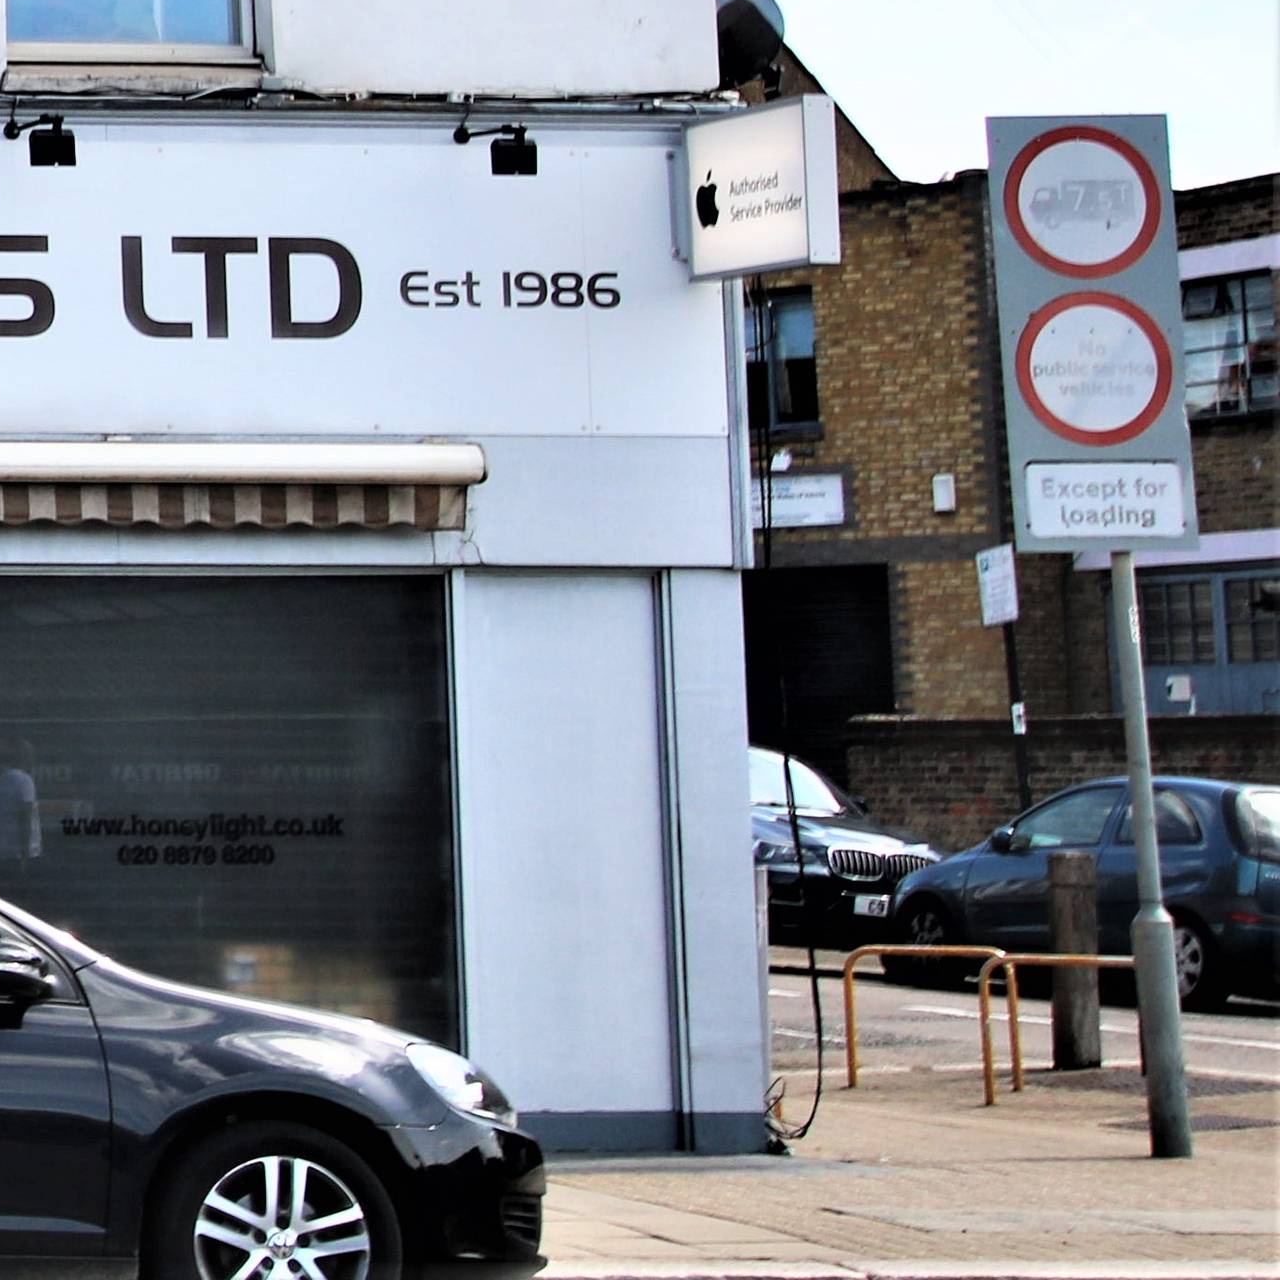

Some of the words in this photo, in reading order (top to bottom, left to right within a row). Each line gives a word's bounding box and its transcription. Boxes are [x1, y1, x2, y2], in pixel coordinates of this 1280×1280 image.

[729, 171, 779, 197] Authorised
[730, 202, 762, 222] Service
[764, 193, 802, 214] Provider
[120, 235, 363, 339] LTD
[400, 271, 481, 308] Est
[502, 271, 621, 308] 1986
[1033, 361, 1088, 378] public
[1042, 477, 1127, 501] Except
[1135, 477, 1168, 497] for
[1060, 505, 1156, 528] loading
[62, 813, 344, 842] www.honeylight.co.uk
[117, 844, 157, 865] 020
[221, 844, 274, 865] 8200
